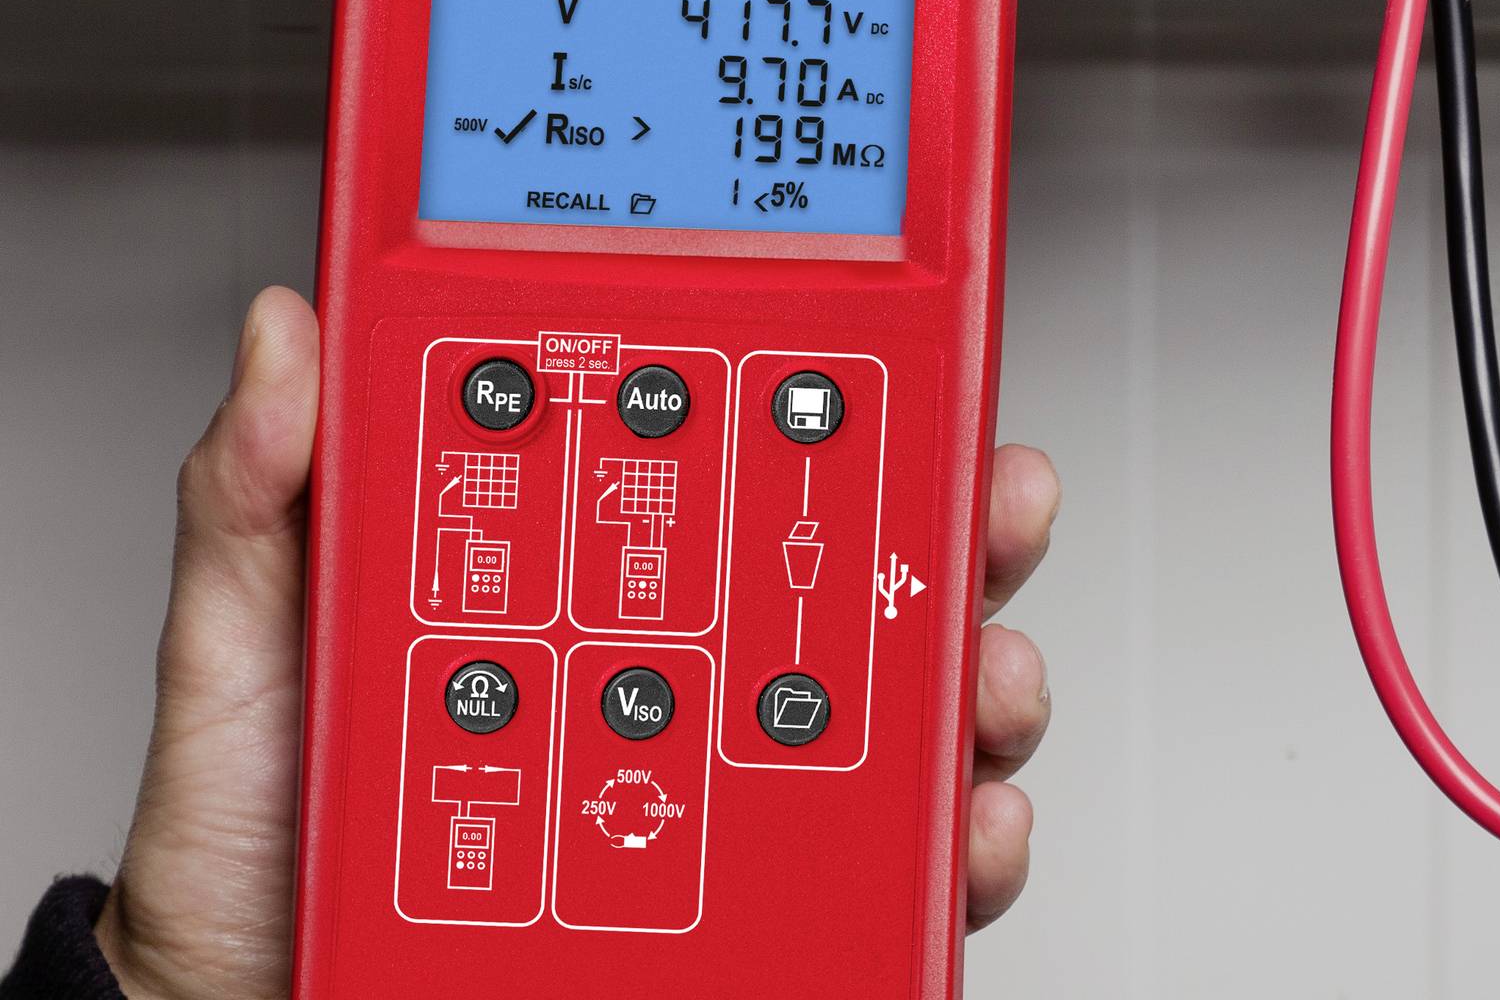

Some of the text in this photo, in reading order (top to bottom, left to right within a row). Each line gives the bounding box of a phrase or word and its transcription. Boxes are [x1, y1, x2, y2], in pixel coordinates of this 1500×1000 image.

[844, 12, 863, 34] V
[871, 23, 888, 35] DC
[719, 56, 828, 108] 9.70
[837, 79, 859, 101] A
[867, 93, 884, 104] DC
[455, 118, 487, 132] 500V
[546, 114, 604, 146] RISO
[735, 115, 824, 165] 199
[527, 192, 610, 210] RECALL
[546, 337, 613, 354] ON/OFF
[545, 357, 609, 370] press 2 sec.
[477, 381, 521, 412] RPE
[626, 386, 681, 411] Auto
[478, 556, 496, 564] 0.00
[634, 562, 653, 570] 0.00
[457, 700, 500, 716] NULL
[618, 687, 662, 722] VISO
[617, 770, 651, 785] 500V
[582, 800, 616, 815] 250V
[643, 802, 685, 818] 1000V
[463, 832, 481, 840] 0.00
